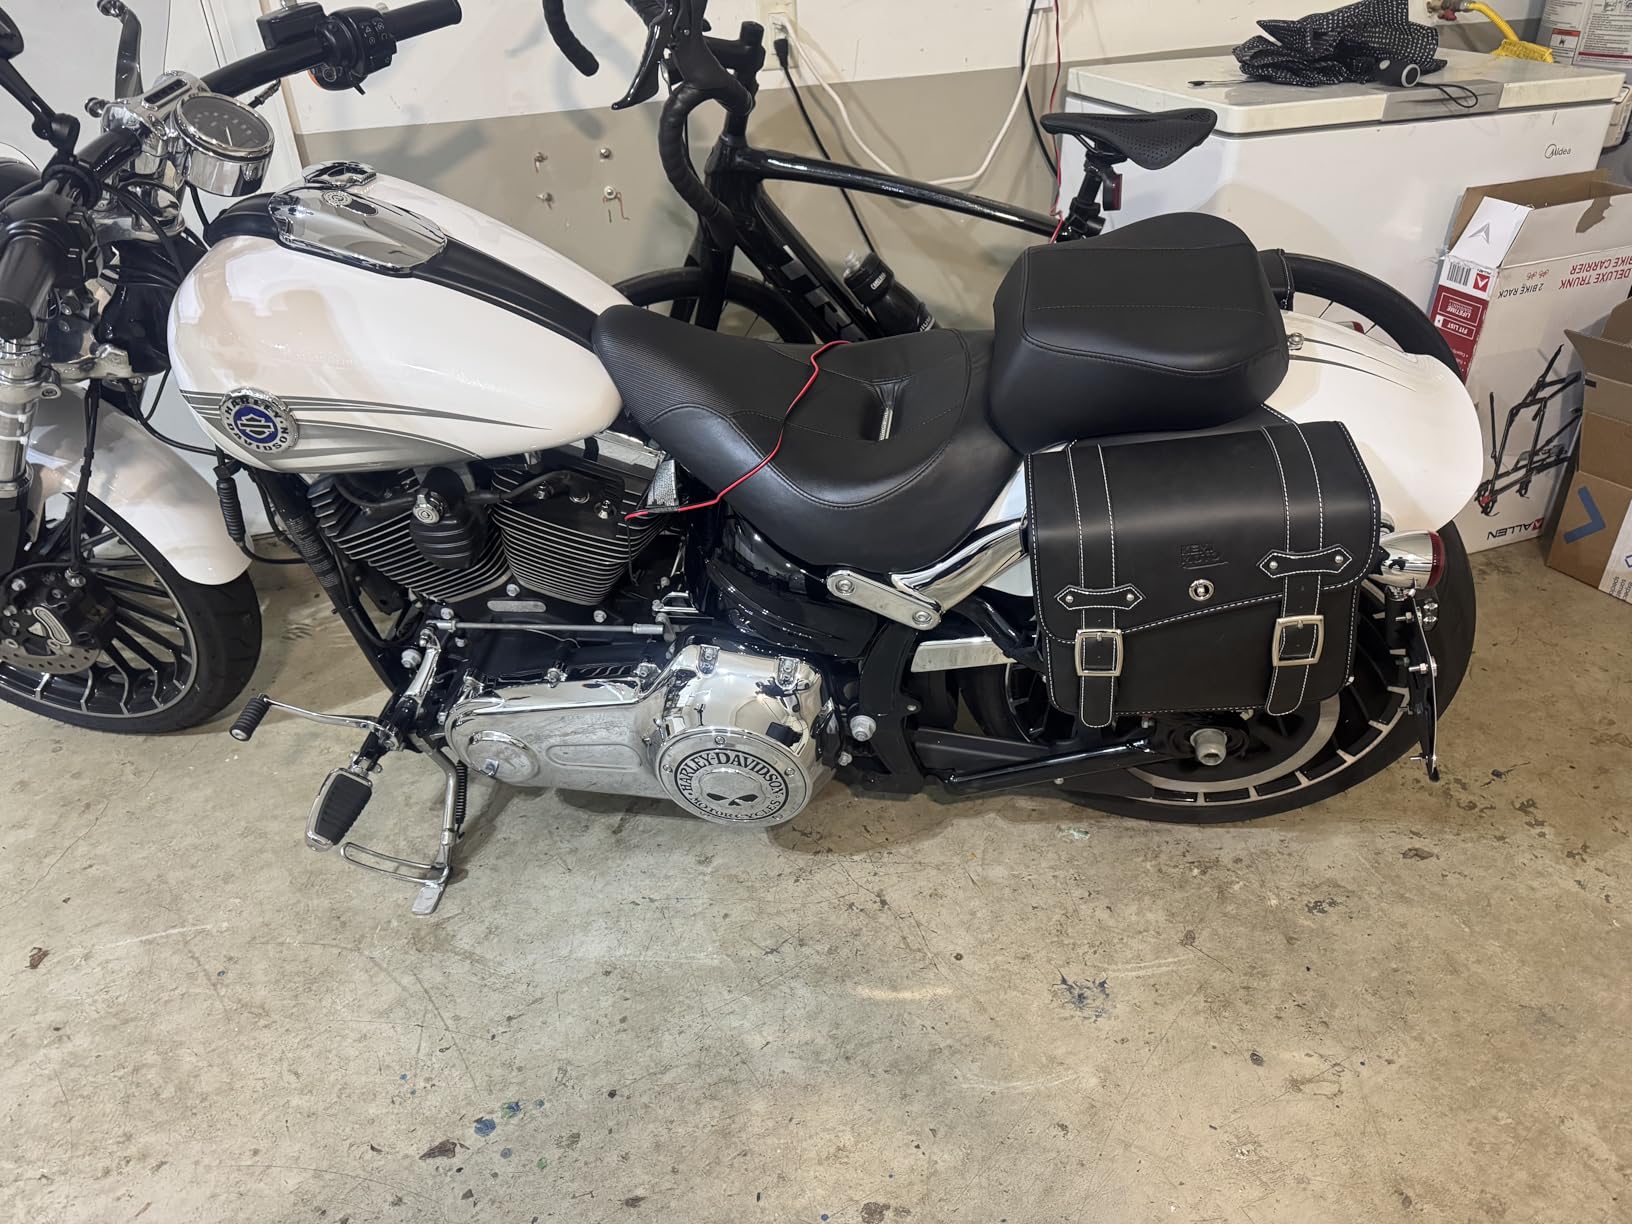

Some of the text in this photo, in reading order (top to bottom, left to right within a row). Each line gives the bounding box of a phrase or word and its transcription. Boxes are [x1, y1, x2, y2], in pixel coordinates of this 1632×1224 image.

[1545, 143, 1572, 159] Midea
[1570, 258, 1612, 275] CARRIER
[1559, 268, 1632, 290] DELUXE TRUNK
[1498, 282, 1545, 299] 2 BIKE RACK
[224, 396, 282, 419] HARLEY
[226, 422, 289, 452] DAVIDSON
[1487, 521, 1534, 541] ALLEN
[679, 753, 784, 796] HARLEY-DAVIDSON
[691, 799, 781, 819] MOTORCYCLES
